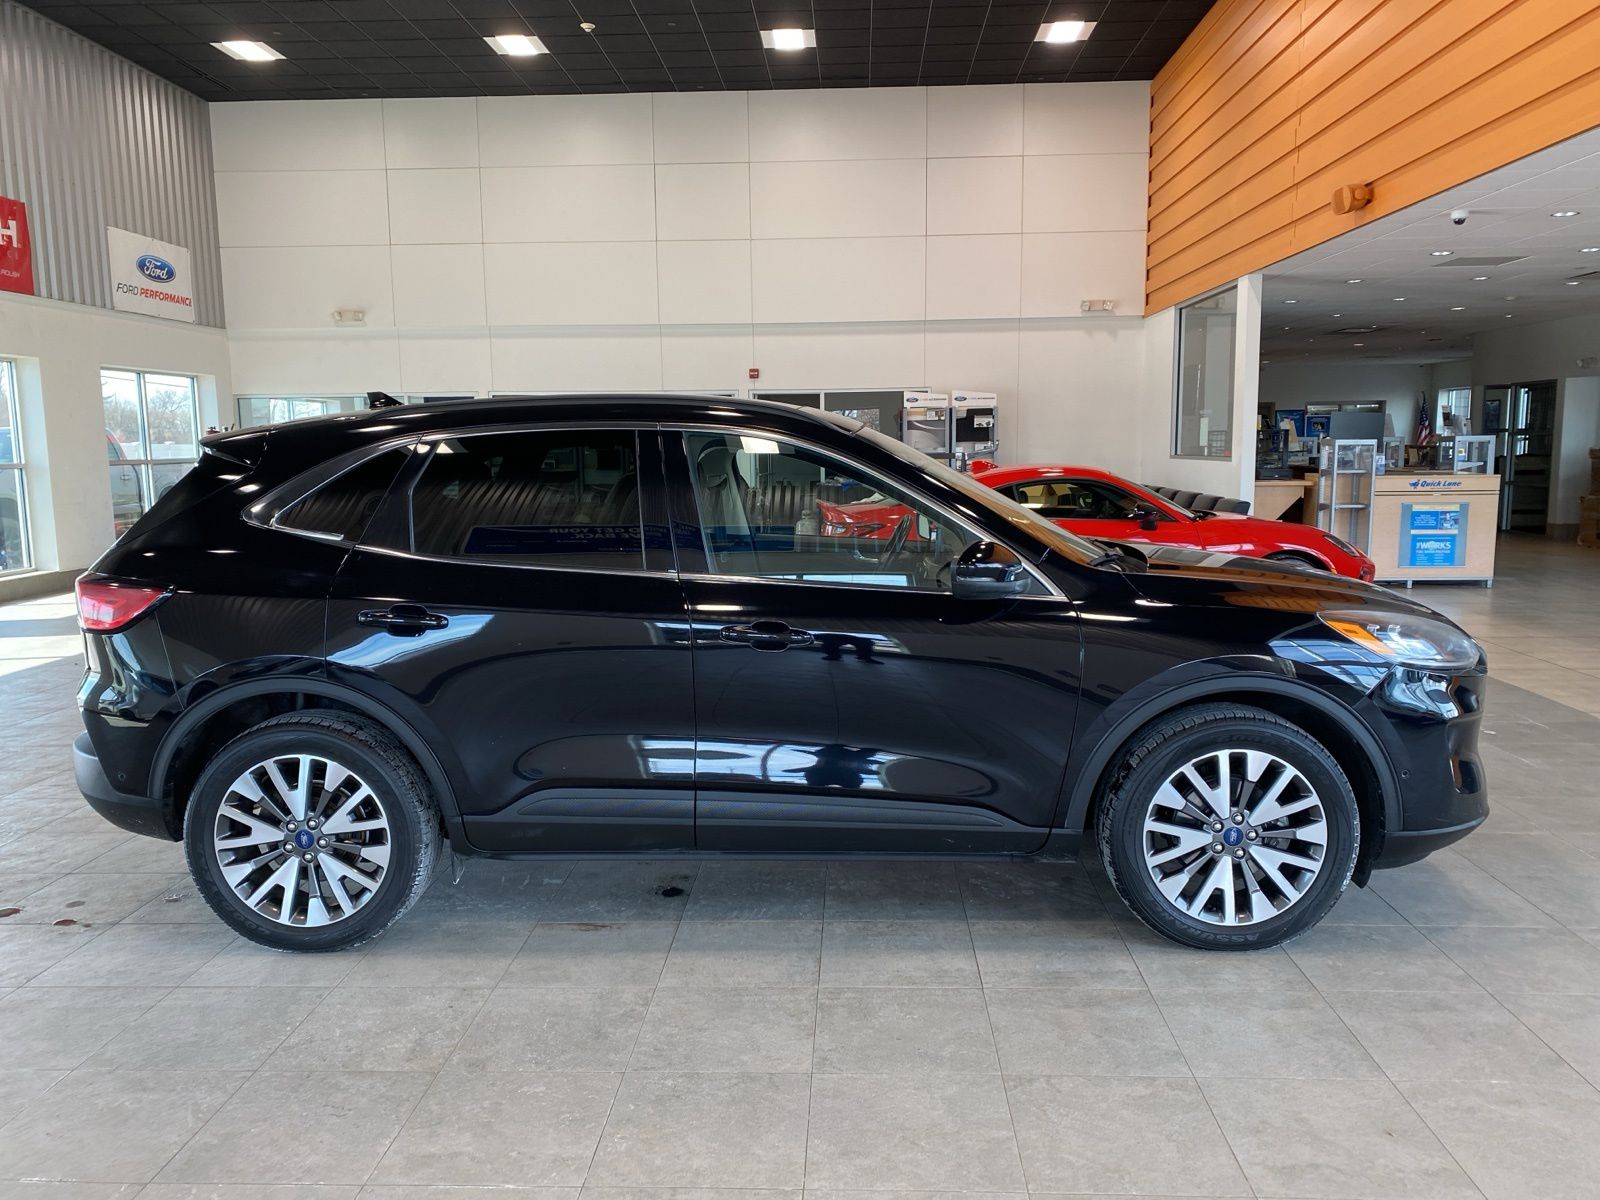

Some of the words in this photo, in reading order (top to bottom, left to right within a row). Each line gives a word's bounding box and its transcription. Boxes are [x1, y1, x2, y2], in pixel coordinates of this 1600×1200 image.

[143, 257, 169, 280] Ford
[116, 282, 139, 296] FORD
[1420, 480, 1442, 488] Quick
